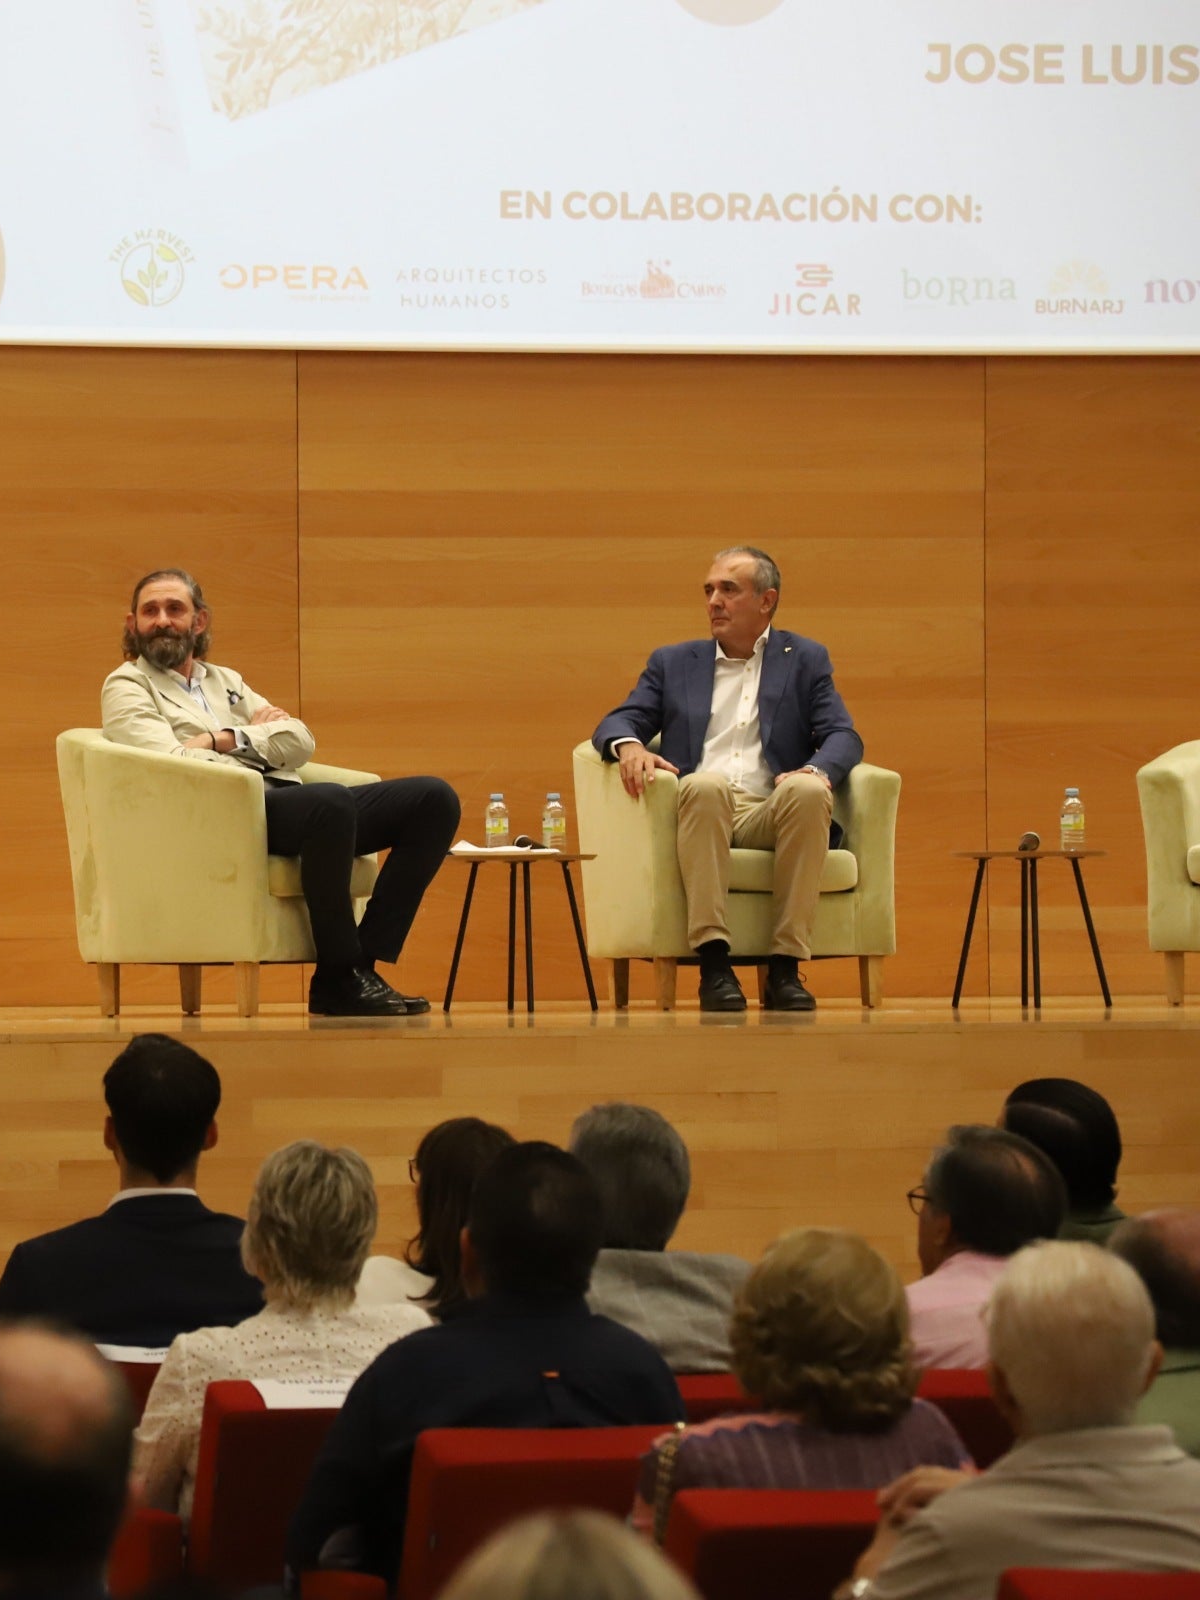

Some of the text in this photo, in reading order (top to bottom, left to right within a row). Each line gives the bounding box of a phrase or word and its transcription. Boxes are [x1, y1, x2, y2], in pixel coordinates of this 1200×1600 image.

[924, 43, 1200, 86] JOSE LUIS
[499, 186, 982, 224] EN COLABORACIÓN CON:
[108, 235, 133, 263] THE
[218, 263, 370, 291] OPERA
[396, 266, 547, 285] ARQUITECTOS
[400, 293, 510, 310] HUMANOS
[1143, 277, 1200, 304] no
[768, 293, 861, 316] JICAR
[1034, 298, 1125, 315] BURNARJ
